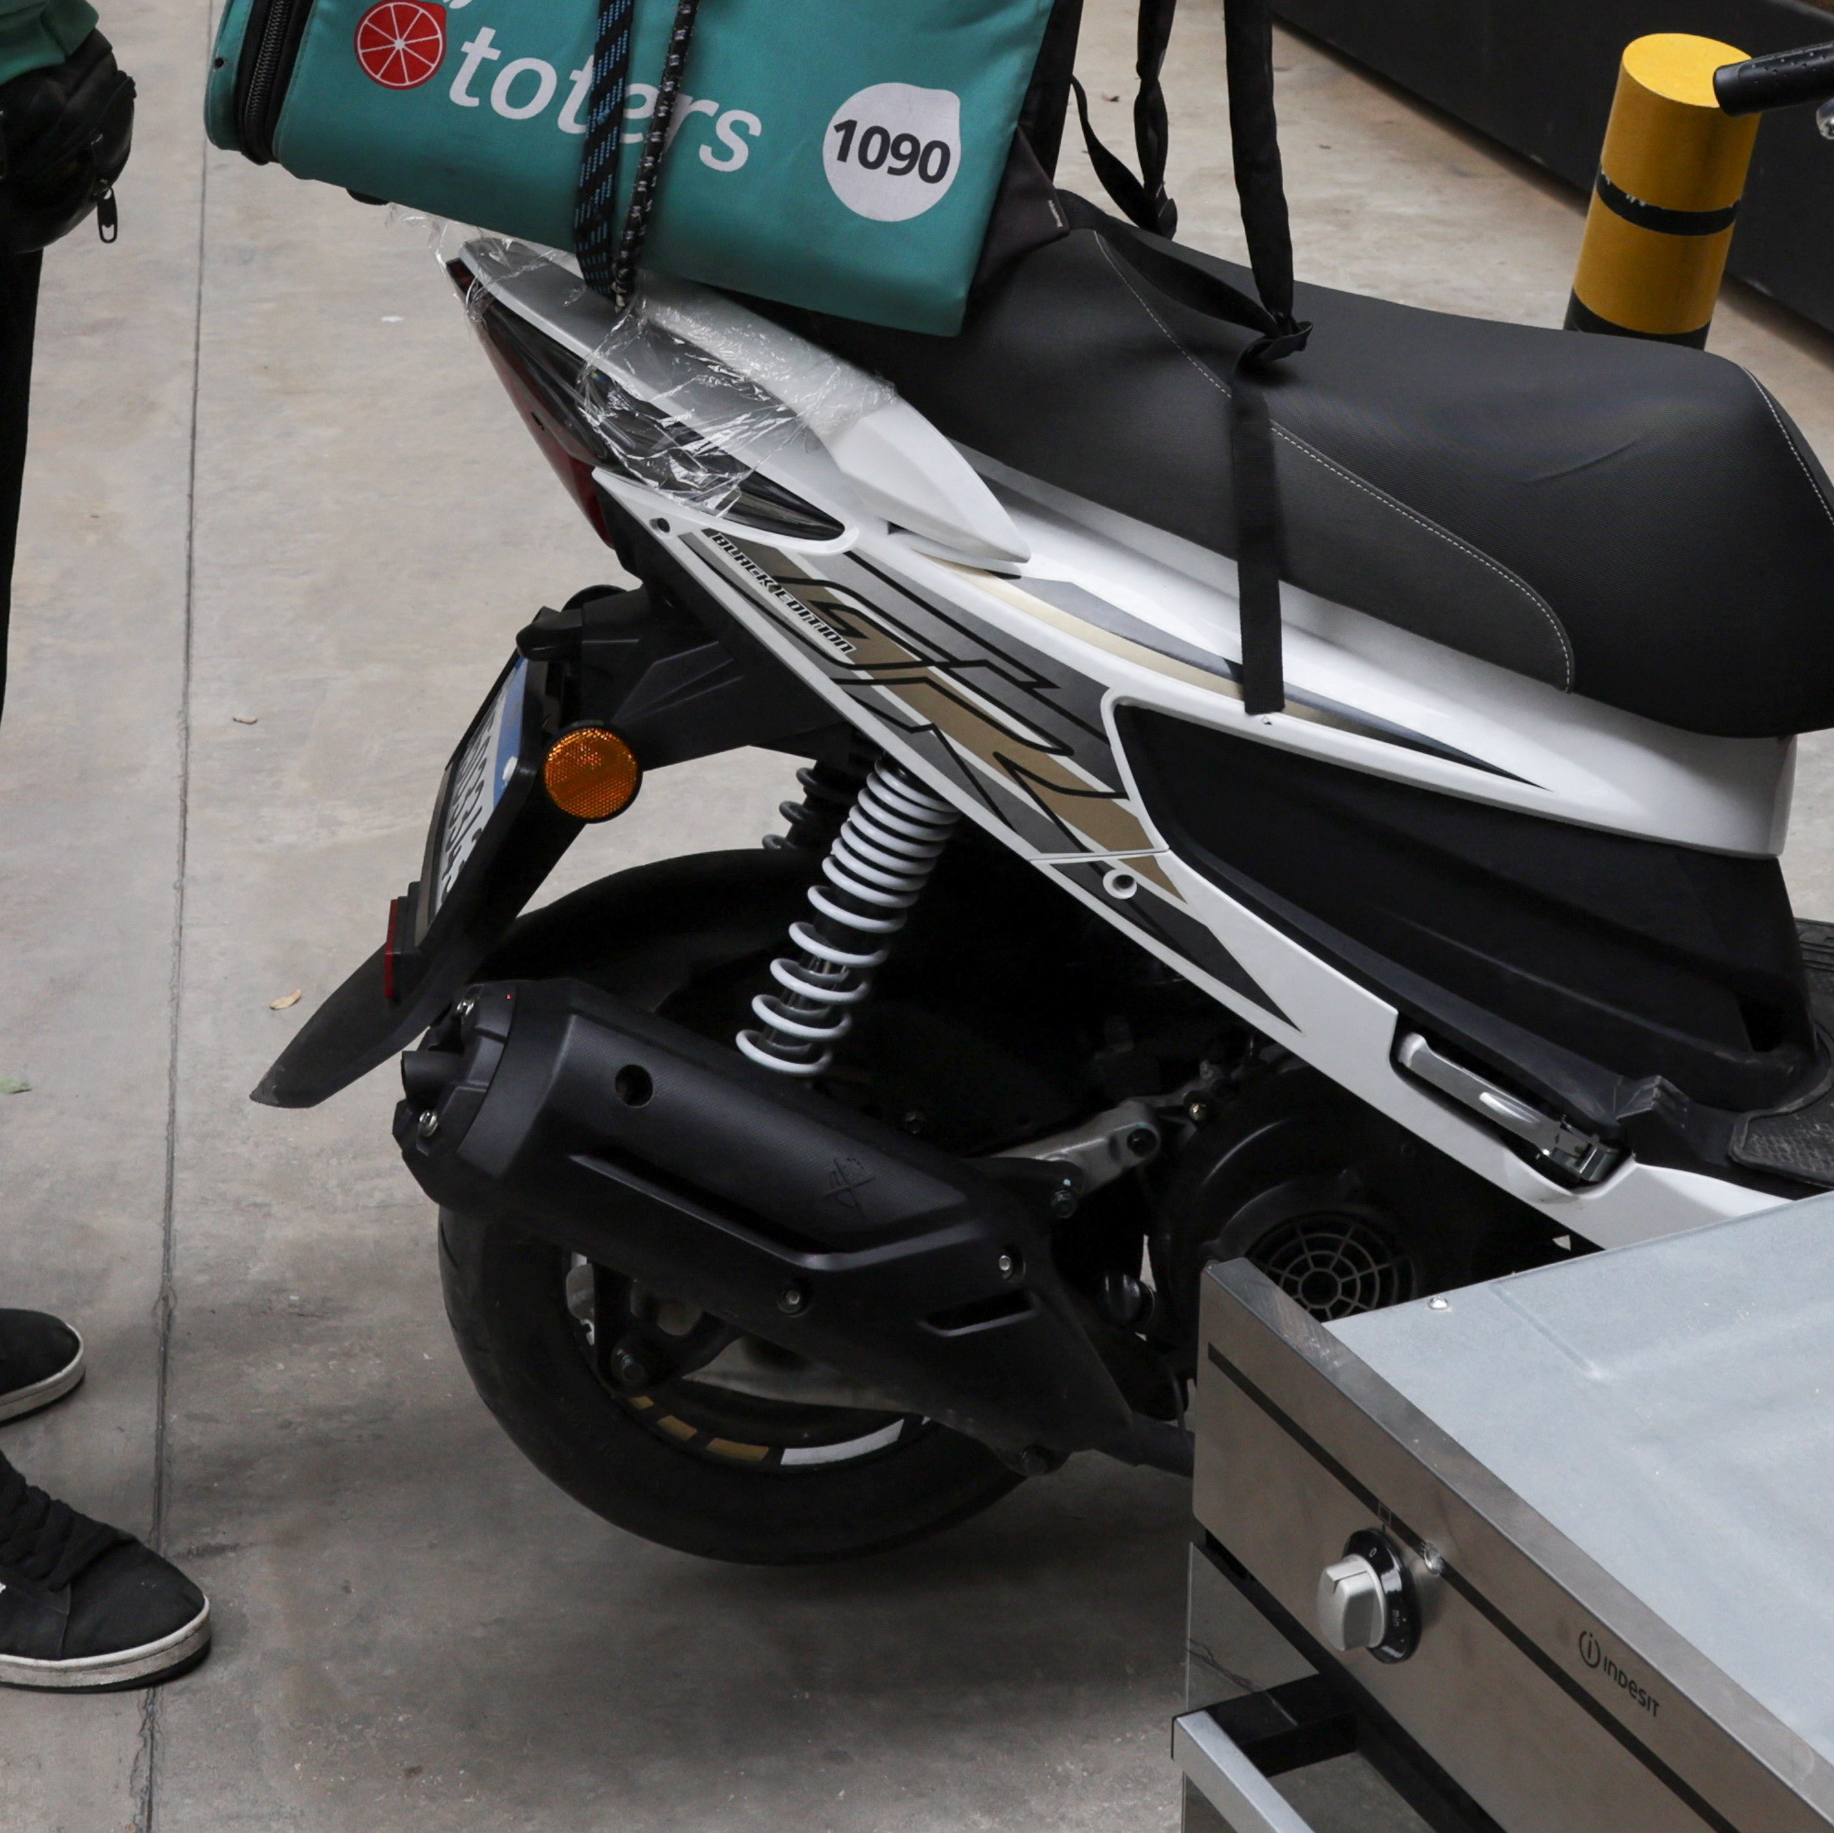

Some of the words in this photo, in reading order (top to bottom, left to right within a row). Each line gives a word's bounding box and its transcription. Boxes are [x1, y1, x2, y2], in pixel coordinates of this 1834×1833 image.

[832, 118, 953, 185] 1090
[712, 533, 774, 588] BLACK
[774, 589, 857, 655] EDITION
